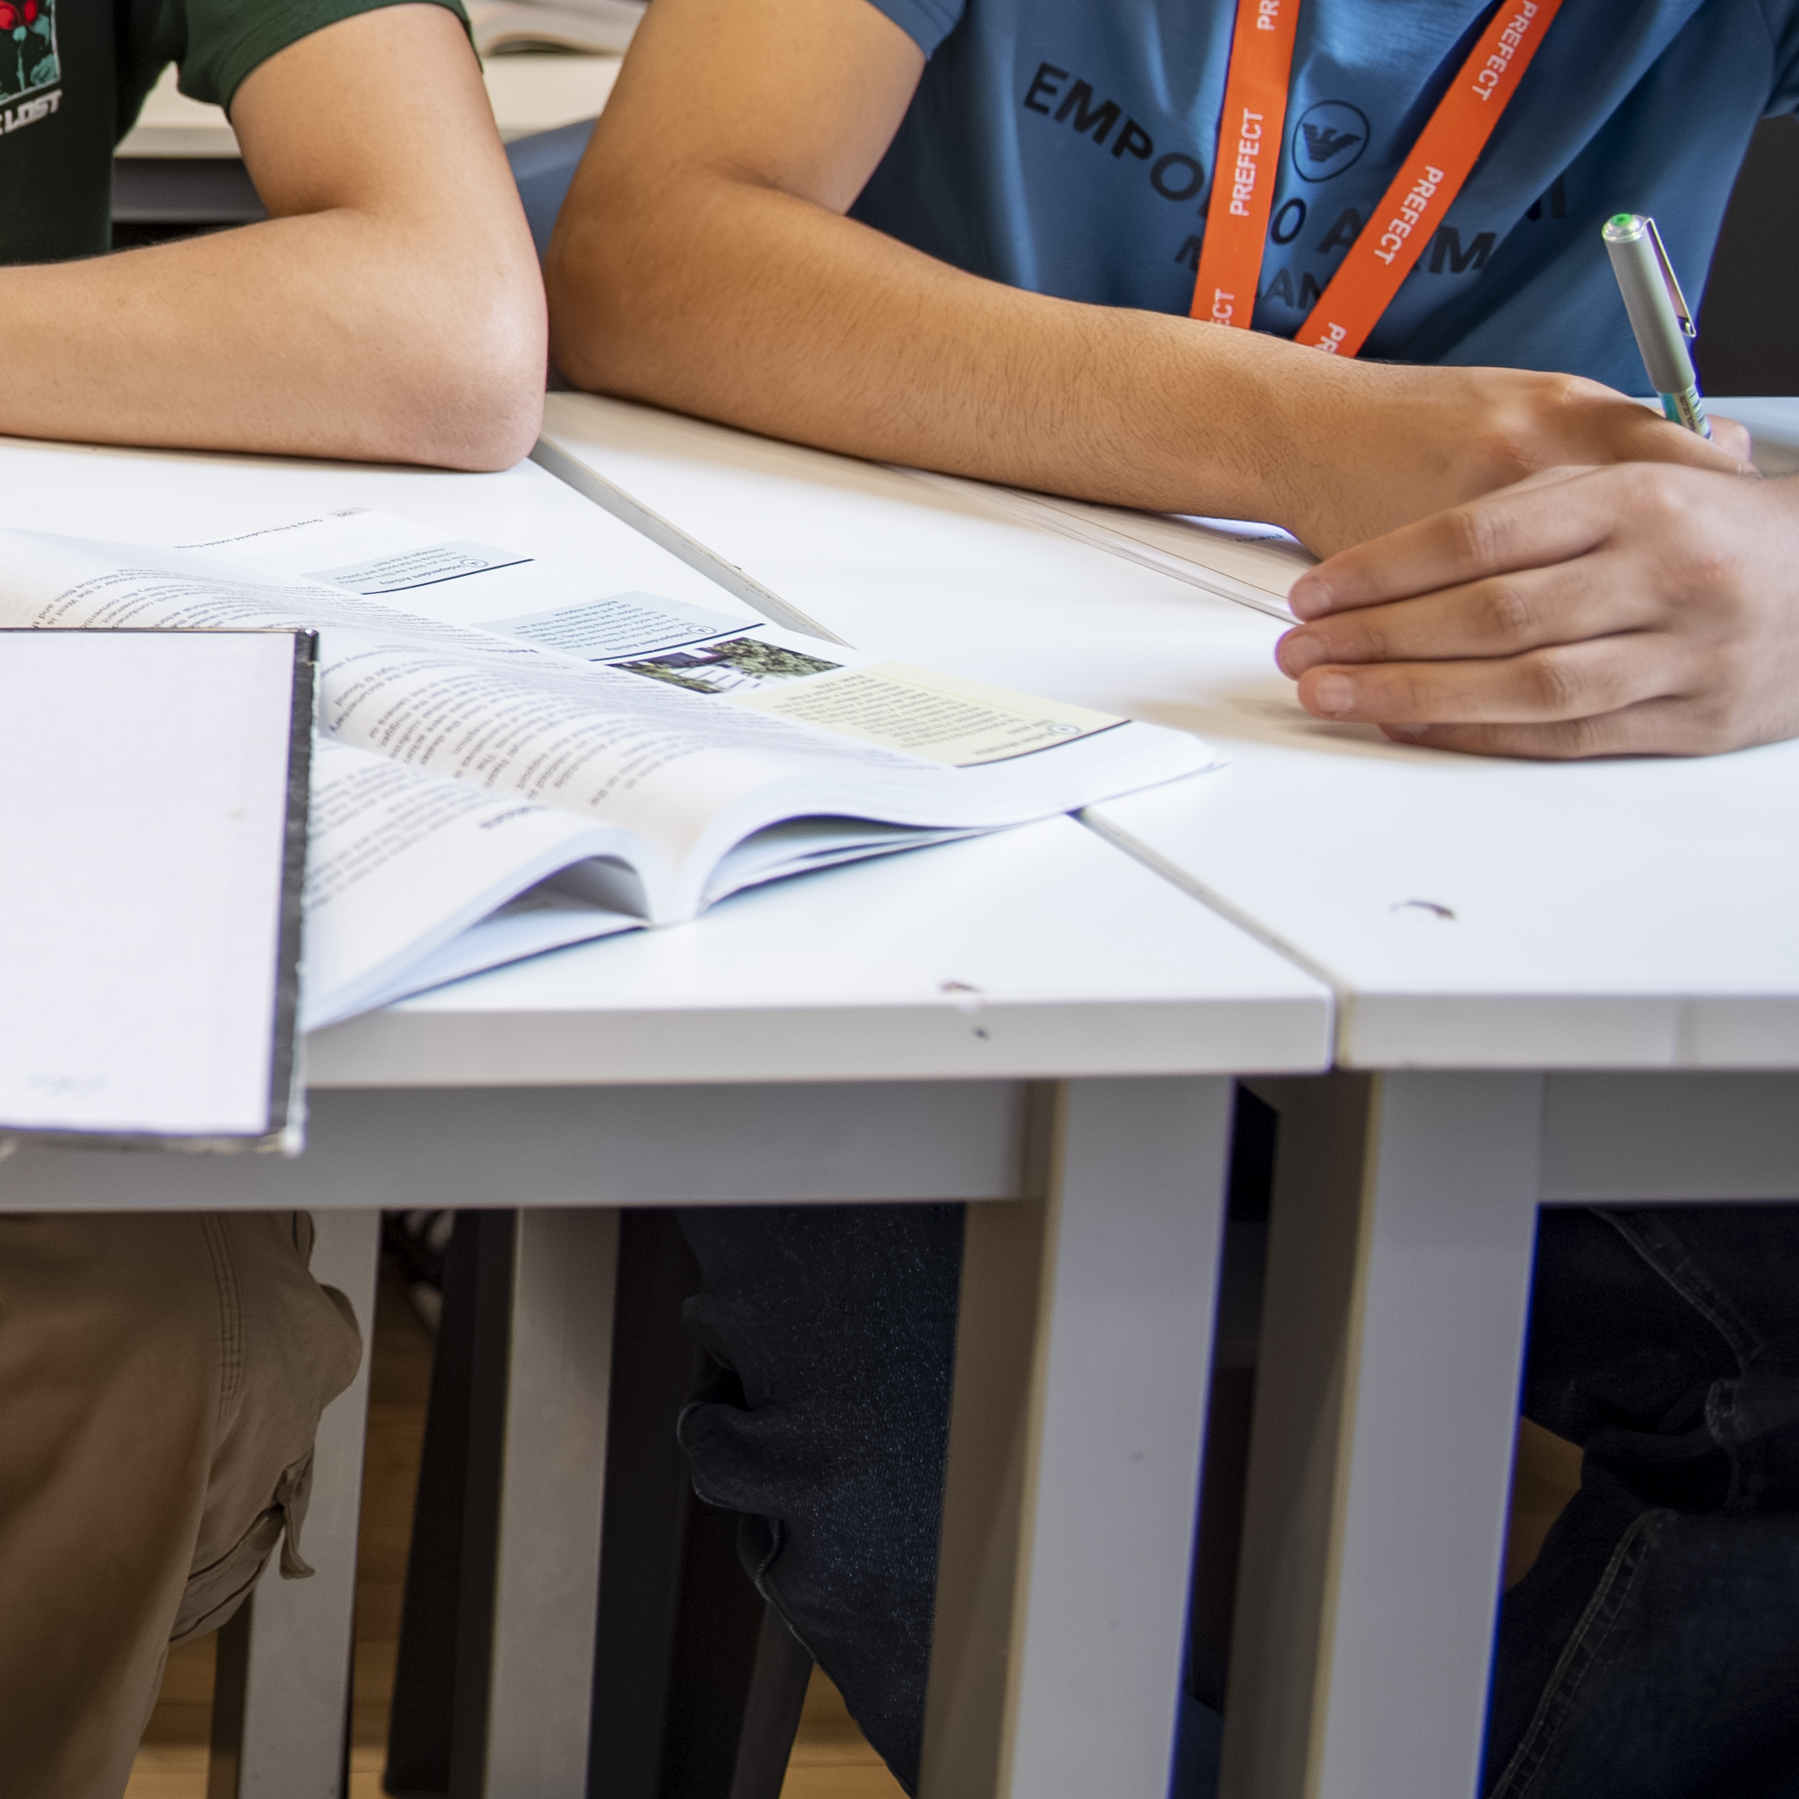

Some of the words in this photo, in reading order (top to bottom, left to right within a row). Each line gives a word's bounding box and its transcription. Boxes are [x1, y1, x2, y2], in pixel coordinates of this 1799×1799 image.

[1470, 0, 1539, 102] PREFECT
[3, 88, 63, 134] LOST
[1023, 60, 1308, 246] EMPOO
[1229, 107, 1266, 218] PREFECT
[1372, 164, 1447, 267] PREFECT
